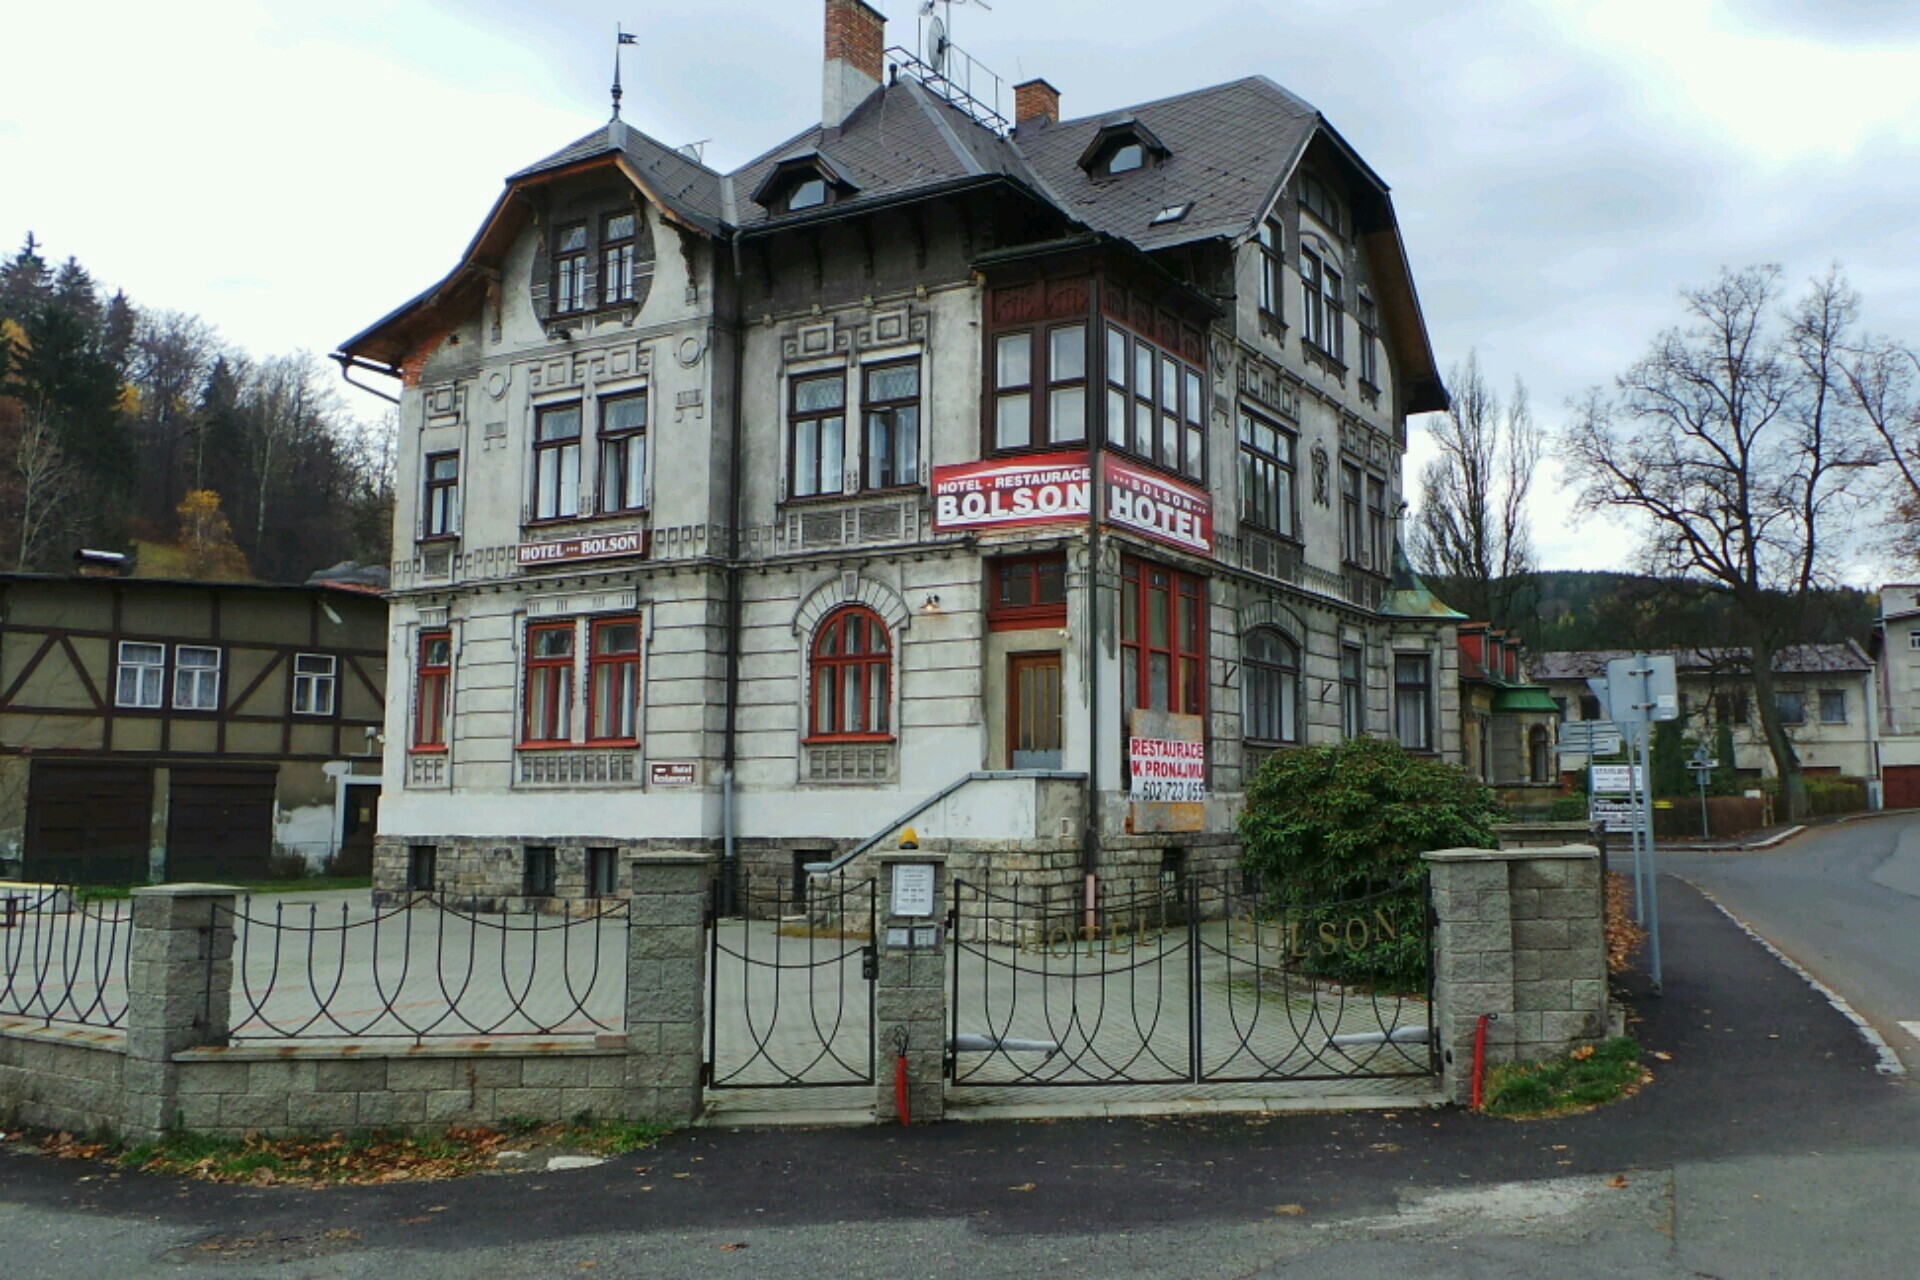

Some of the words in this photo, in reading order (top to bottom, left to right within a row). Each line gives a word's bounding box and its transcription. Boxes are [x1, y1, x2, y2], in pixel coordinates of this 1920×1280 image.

[938, 481, 983, 494] HOTEL
[995, 467, 1091, 490] RESTAURACE
[1131, 479, 1193, 511] BOLSON
[937, 483, 1091, 522] BOLSON
[1109, 485, 1209, 550] HOTEL
[521, 544, 564, 561] HOTEL
[581, 535, 637, 554] BOLSON
[1131, 738, 1204, 758] RESTAURACE
[1020, 915, 1156, 960] HOTEL
[1232, 908, 1397, 957] BOLSON
